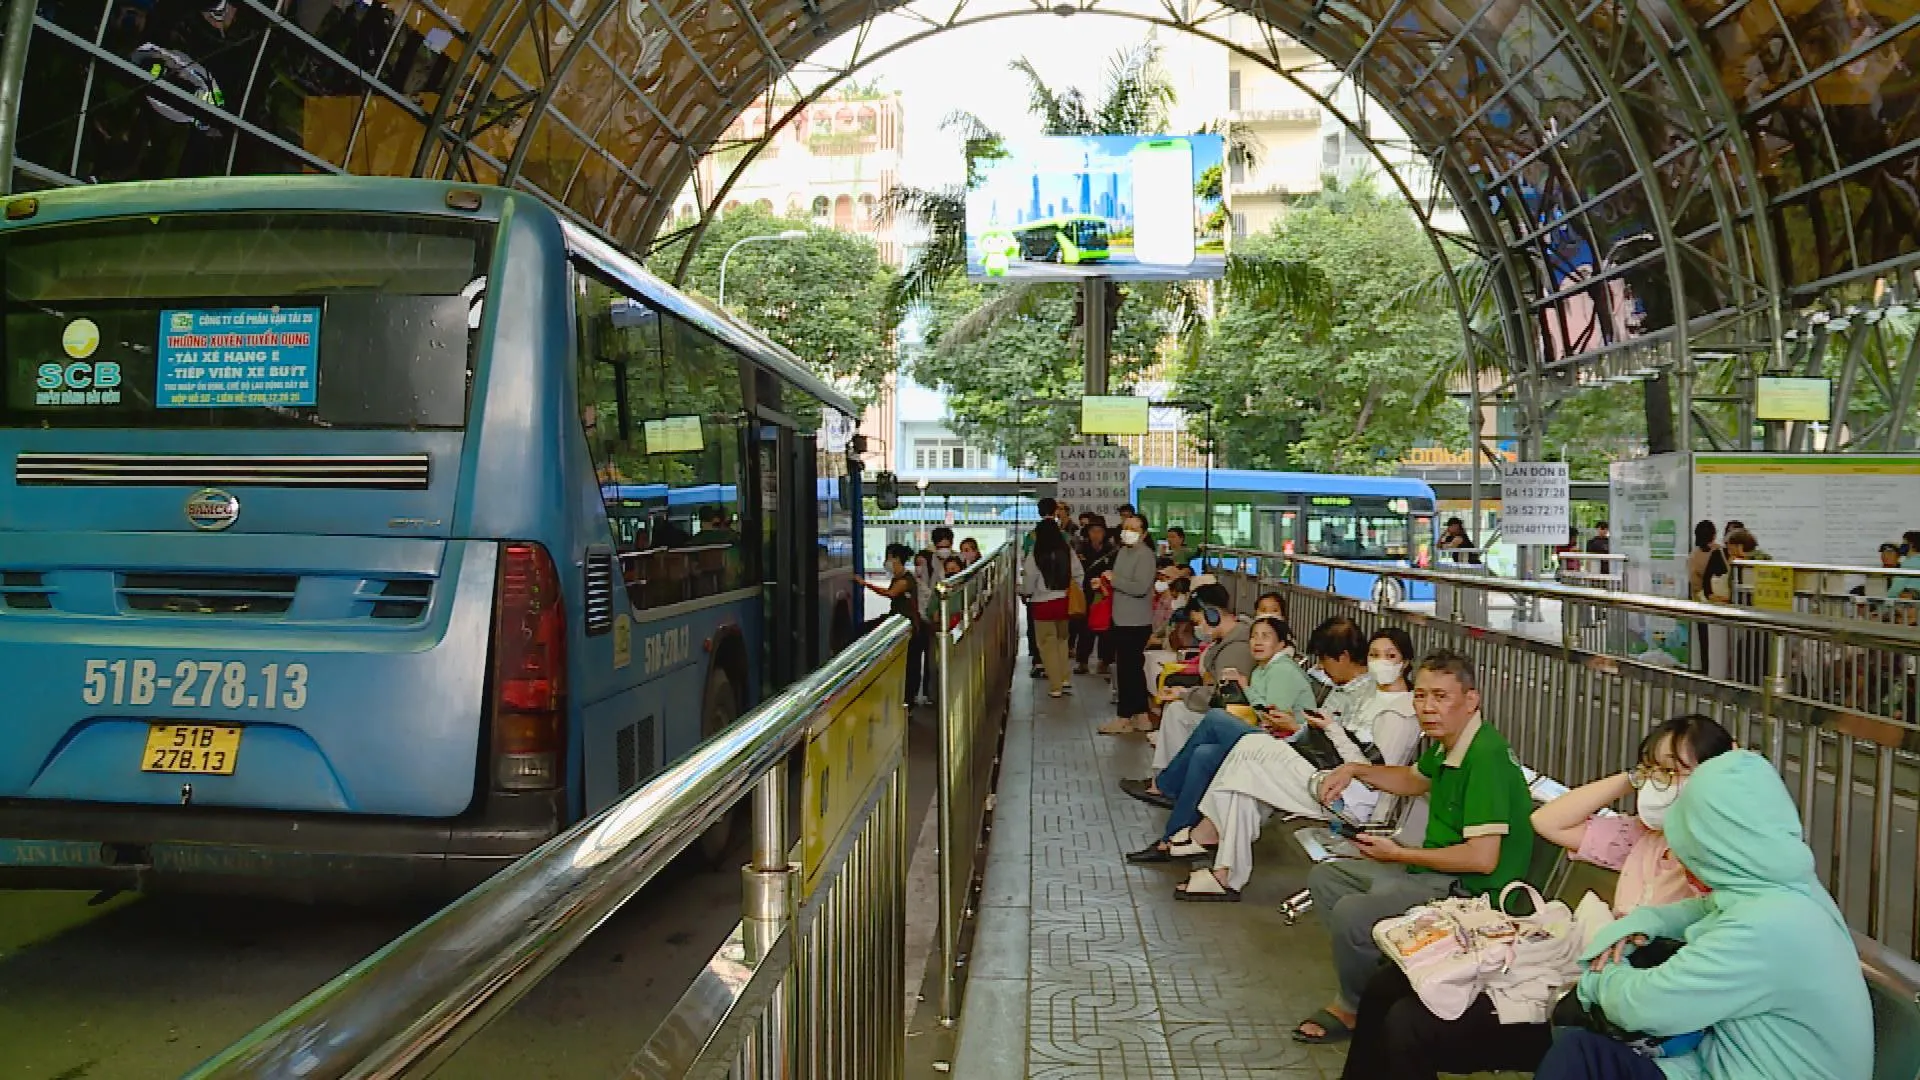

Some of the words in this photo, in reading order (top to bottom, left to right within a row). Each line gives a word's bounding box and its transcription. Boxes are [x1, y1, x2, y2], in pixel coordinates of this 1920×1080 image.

[37, 361, 122, 389] SCB
[1505, 487, 1518, 497] 04
[1522, 487, 1534, 497] 13
[1537, 487, 1550, 497] 27
[188, 503, 233, 515] SAMCO
[82, 659, 309, 710] 51B-278.13
[173, 727, 214, 748] 51B
[151, 749, 226, 771] 278.13
